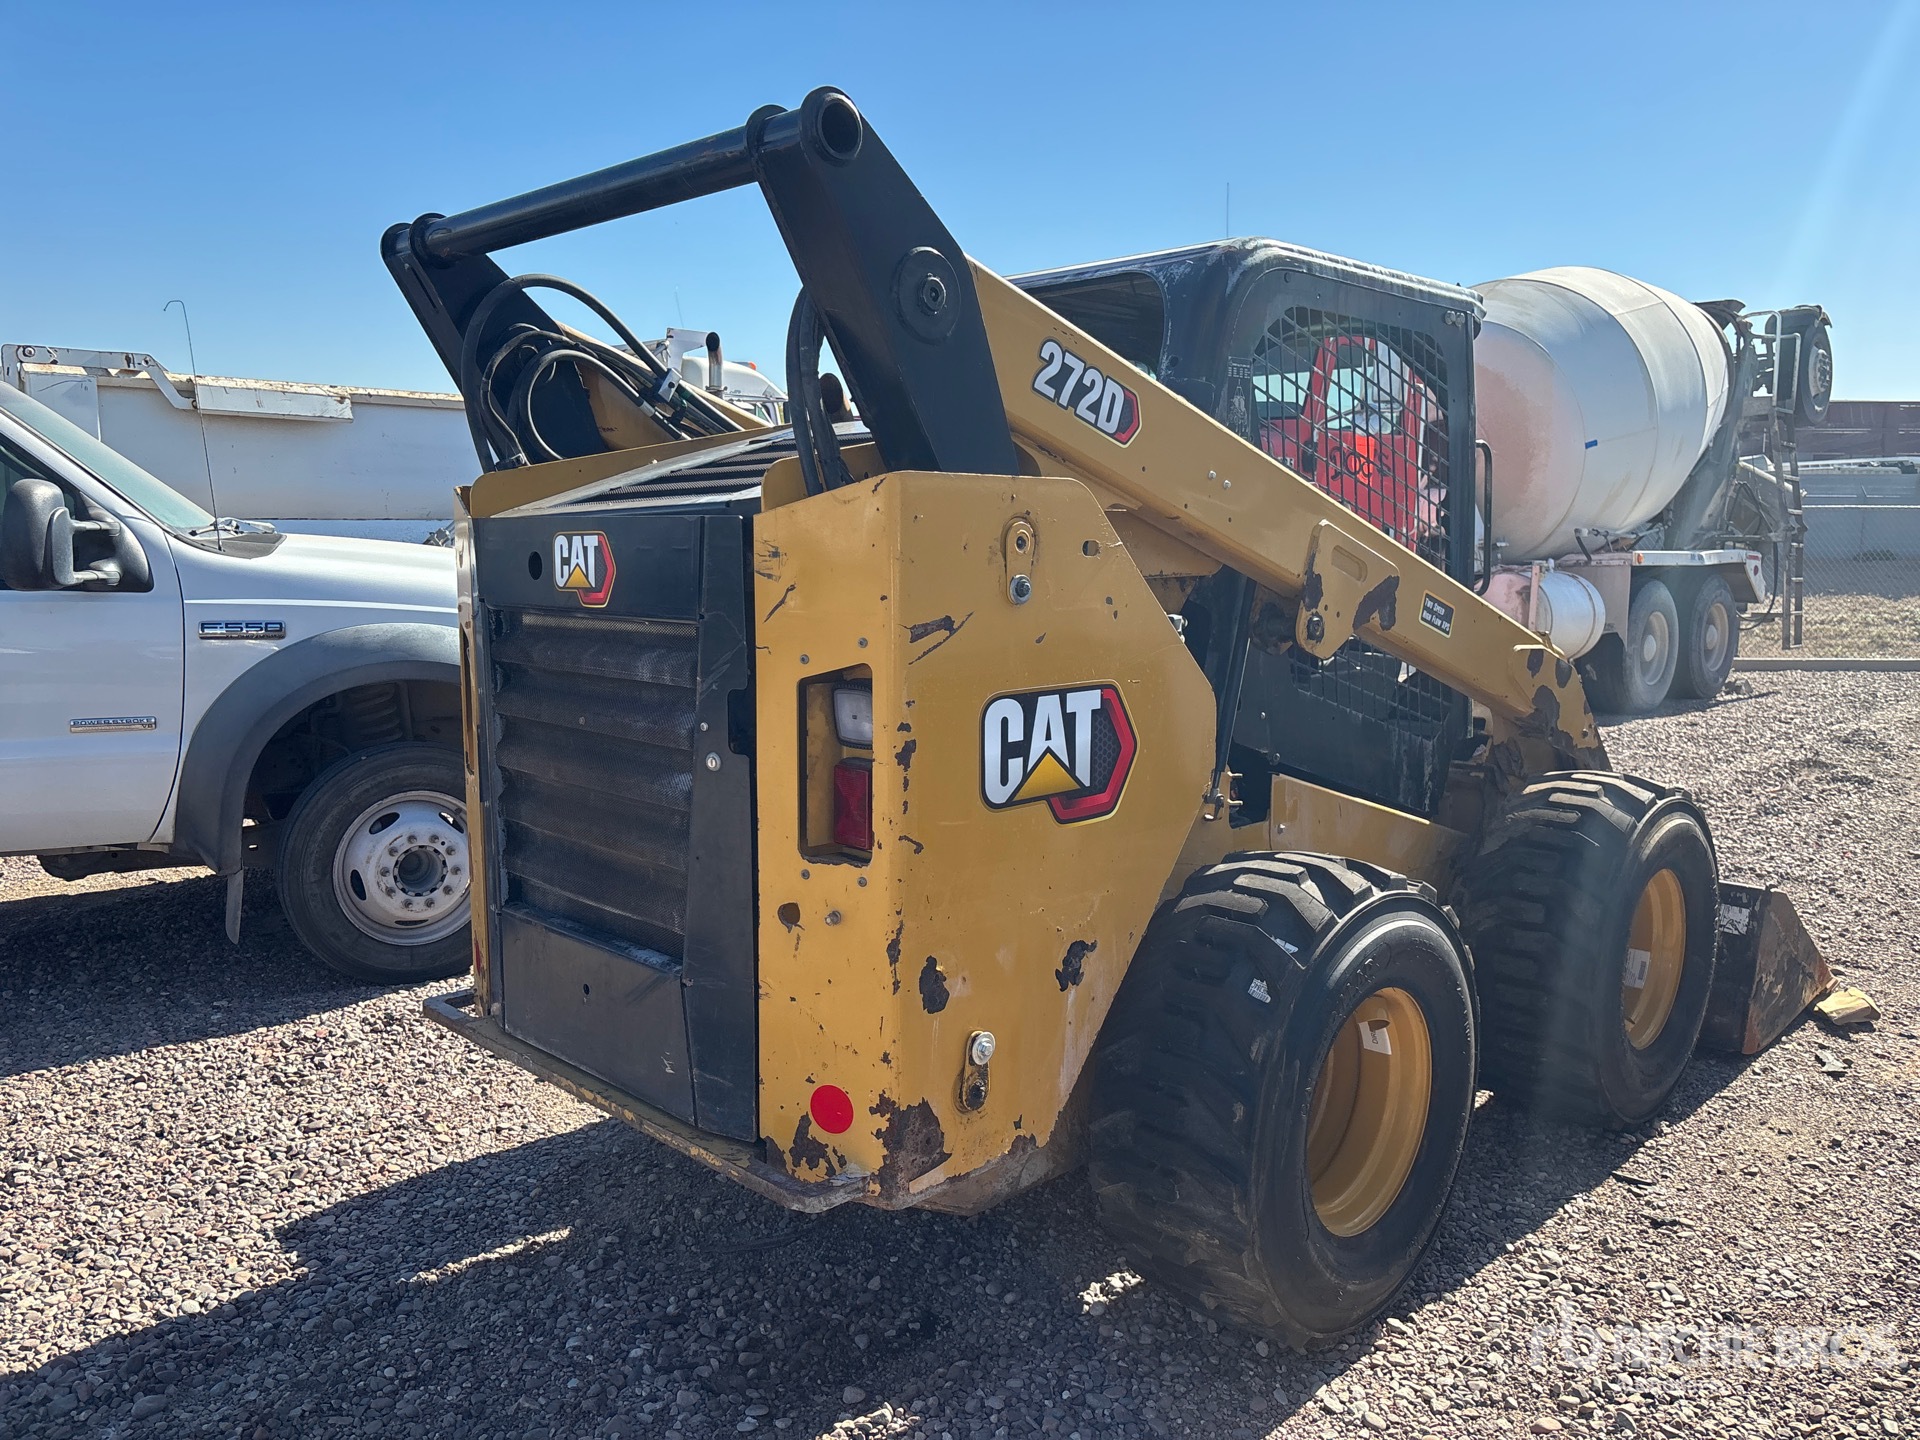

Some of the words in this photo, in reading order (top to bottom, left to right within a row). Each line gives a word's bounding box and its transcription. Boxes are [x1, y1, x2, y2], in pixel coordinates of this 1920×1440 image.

[1033, 340, 1125, 435] 272D
[554, 534, 599, 588] CAT
[201, 622, 283, 633] F-550
[984, 689, 1101, 804] CAT
